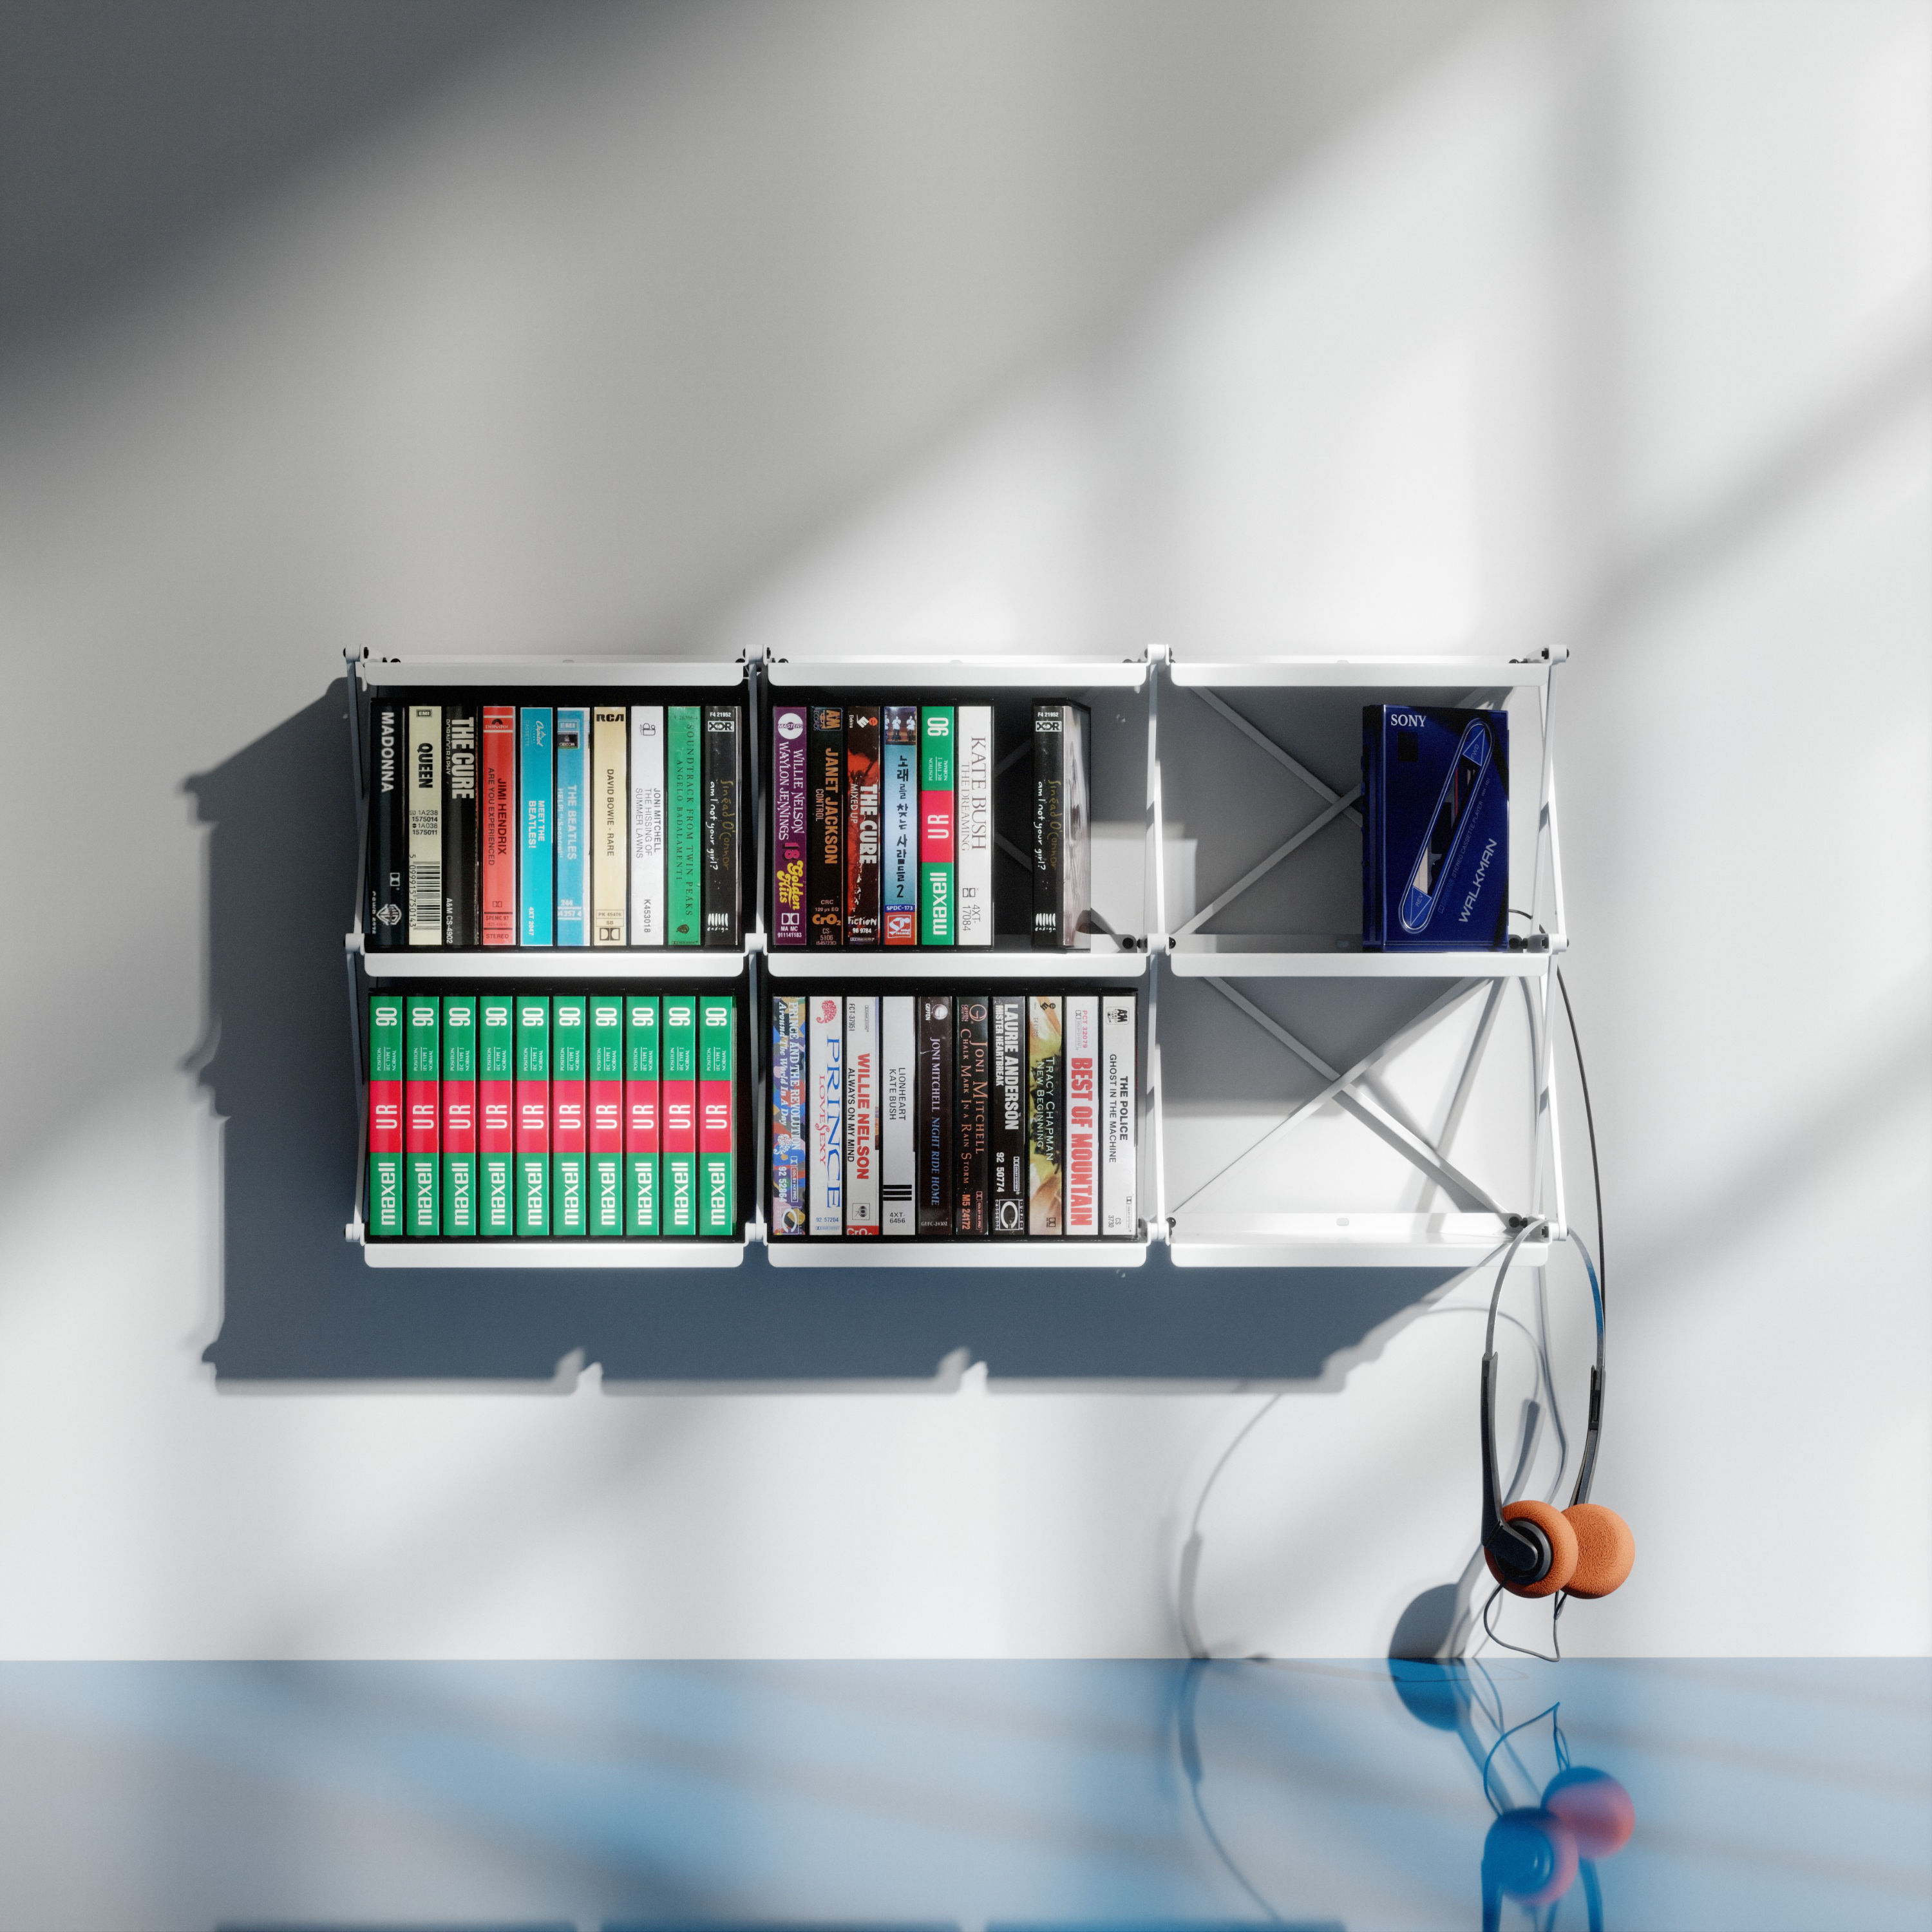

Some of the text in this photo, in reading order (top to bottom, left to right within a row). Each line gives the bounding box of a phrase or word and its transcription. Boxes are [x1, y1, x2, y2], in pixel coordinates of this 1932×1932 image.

[928, 717, 949, 736] 90
[1391, 714, 1426, 726] SONY
[381, 712, 394, 792] MADONNA
[419, 743, 433, 788] QUEEN
[452, 717, 474, 799] THE CURE
[710, 781, 715, 797] am
[778, 742, 789, 840] WAYLON JENNINGS
[793, 750, 804, 833] WILLIE NELSON
[825, 748, 838, 864] JANET JACKSON
[971, 737, 986, 849] KATE BUSH
[498, 804, 506, 855] HENDRIX
[568, 785, 577, 859] THE BEATLES
[706, 823, 715, 845] your
[860, 784, 876, 864] THE CURE
[896, 755, 909, 898] 노래를 찾는 사람들 2
[927, 815, 949, 839] UR
[1452, 855, 1463, 878] STEREO
[1461, 823, 1475, 854] CASSETTE
[1473, 800, 1483, 824] PLAYER
[645, 845, 652, 855] OF
[707, 849, 718, 870] girl?
[777, 871, 791, 904] Hits
[784, 842, 803, 910] 18 Golden
[1415, 893, 1423, 907] REV
[1458, 838, 1498, 923] WALKMAN
[930, 873, 947, 934] maxell
[376, 1007, 397, 1026] 90
[522, 1007, 544, 1026] 90
[669, 1007, 690, 1026] 90
[779, 1003, 788, 1038] Around
[780, 1057, 788, 1084] World
[780, 1087, 787, 1096] In
[788, 1002, 800, 1150] PRINCE AND THE REVOLUTION
[1005, 1005, 1018, 1130] LAURIE ANDERSON
[376, 1105, 397, 1128] UR
[523, 1105, 544, 1128] UR
[669, 1105, 690, 1128] UR
[779, 1108, 787, 1126] Day
[848, 1107, 855, 1121] ON
[857, 1054, 869, 1179] WILLIE NELSON
[1110, 1089, 1117, 1098] IN
[815, 1075, 830, 1166] LOVESEXY
[827, 1036, 840, 1208] PRINCE
[848, 1123, 855, 1137] MY
[930, 1037, 940, 1205] JONI MITCHELL NIGHT RIDE HOME
[1071, 1058, 1092, 1226] BEST OF MOUNTAIN
[997, 1152, 1004, 1163] 92
[379, 1163, 395, 1225] maxell
[452, 1163, 468, 1225] maxell
[526, 1163, 542, 1225] maxell
[598, 1163, 615, 1225] maxell
[672, 1163, 688, 1225] maxell
[779, 1167, 787, 1202] 92 52864
[962, 1209, 971, 1229] 24172
